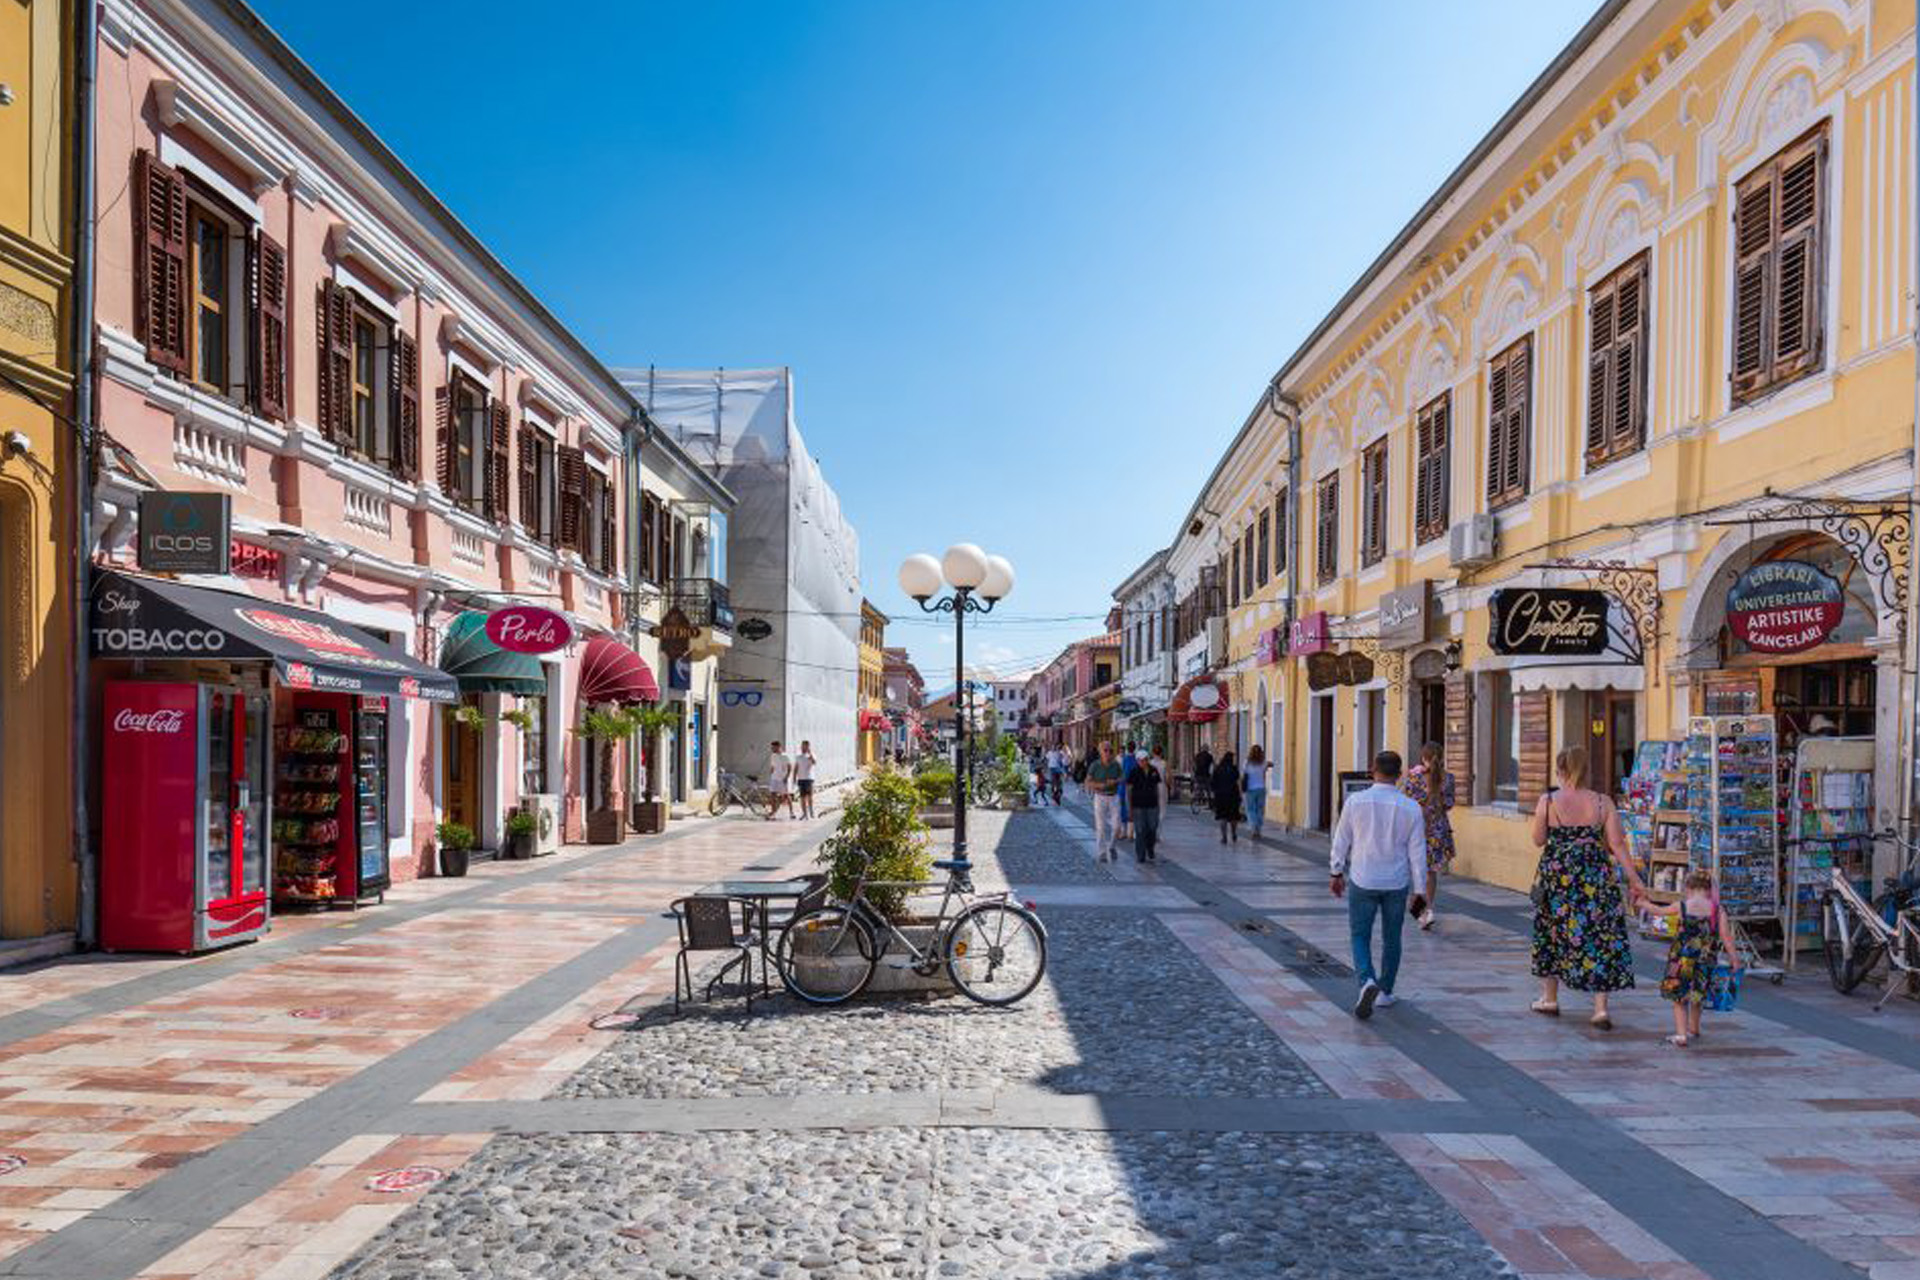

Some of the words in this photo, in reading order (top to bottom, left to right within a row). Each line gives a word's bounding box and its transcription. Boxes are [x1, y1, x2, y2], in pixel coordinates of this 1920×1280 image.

[149, 534, 213, 551] IQOS
[1750, 566, 1814, 588] LIBRARI
[98, 591, 141, 615] Shop
[500, 613, 556, 644] Perla
[1505, 591, 1600, 652] Cleopatra
[1747, 607, 1824, 630] ARTISTIKE
[92, 629, 225, 651] TOBACCO
[1748, 625, 1823, 648] KANCELARI
[113, 708, 188, 733] Coca-Cola
